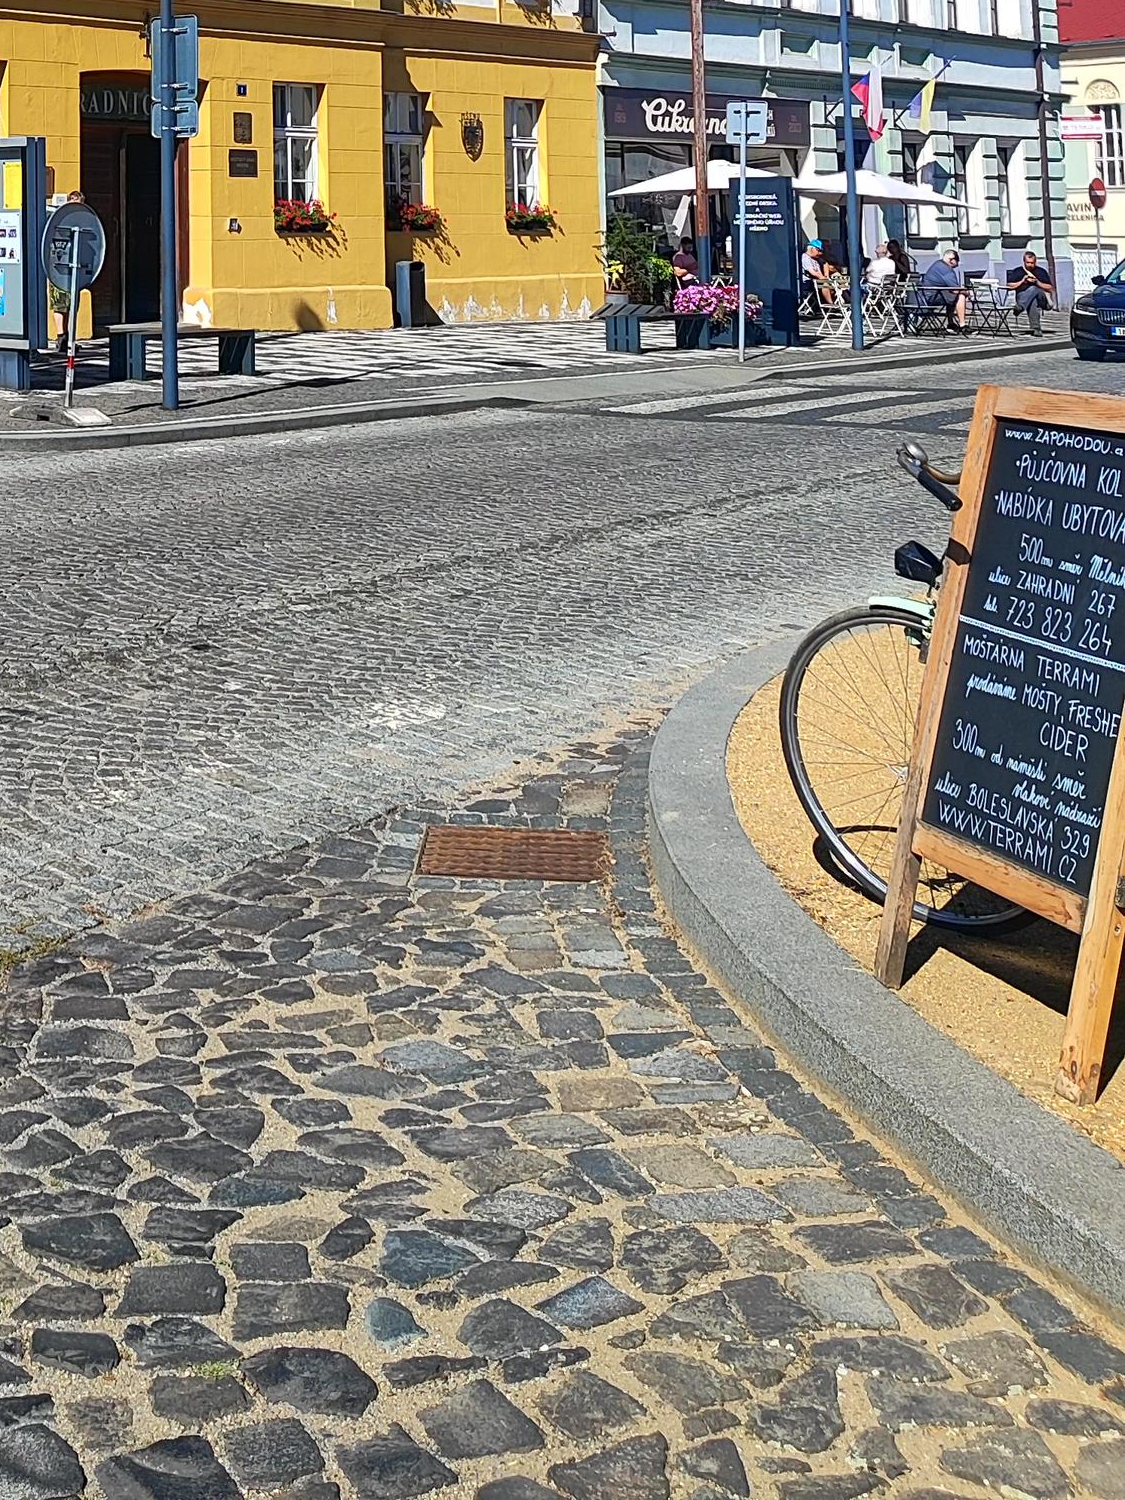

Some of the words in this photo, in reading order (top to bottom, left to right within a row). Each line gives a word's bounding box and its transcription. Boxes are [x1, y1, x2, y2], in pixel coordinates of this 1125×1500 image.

[997, 486, 1053, 526] NABÍDKA
[1097, 466, 1123, 498] KOL
[1017, 570, 1080, 605] ZAHRADNÍ
[1088, 590, 1116, 618] 267
[1006, 597, 1035, 629] 723
[1041, 607, 1073, 643] 823
[1078, 619, 1112, 656] 264
[963, 633, 1025, 673] MOŠTÁRNA
[1036, 655, 1100, 698] TERRAMI
[952, 718, 986, 758] 300m
[991, 744, 1004, 766] od
[1040, 721, 1089, 763] CIDER
[966, 783, 1058, 844] BOLESLAVSKÁ
[1061, 826, 1091, 859] 329
[1012, 780, 1056, 810] vlakové
[1054, 801, 1102, 829] nádraží
